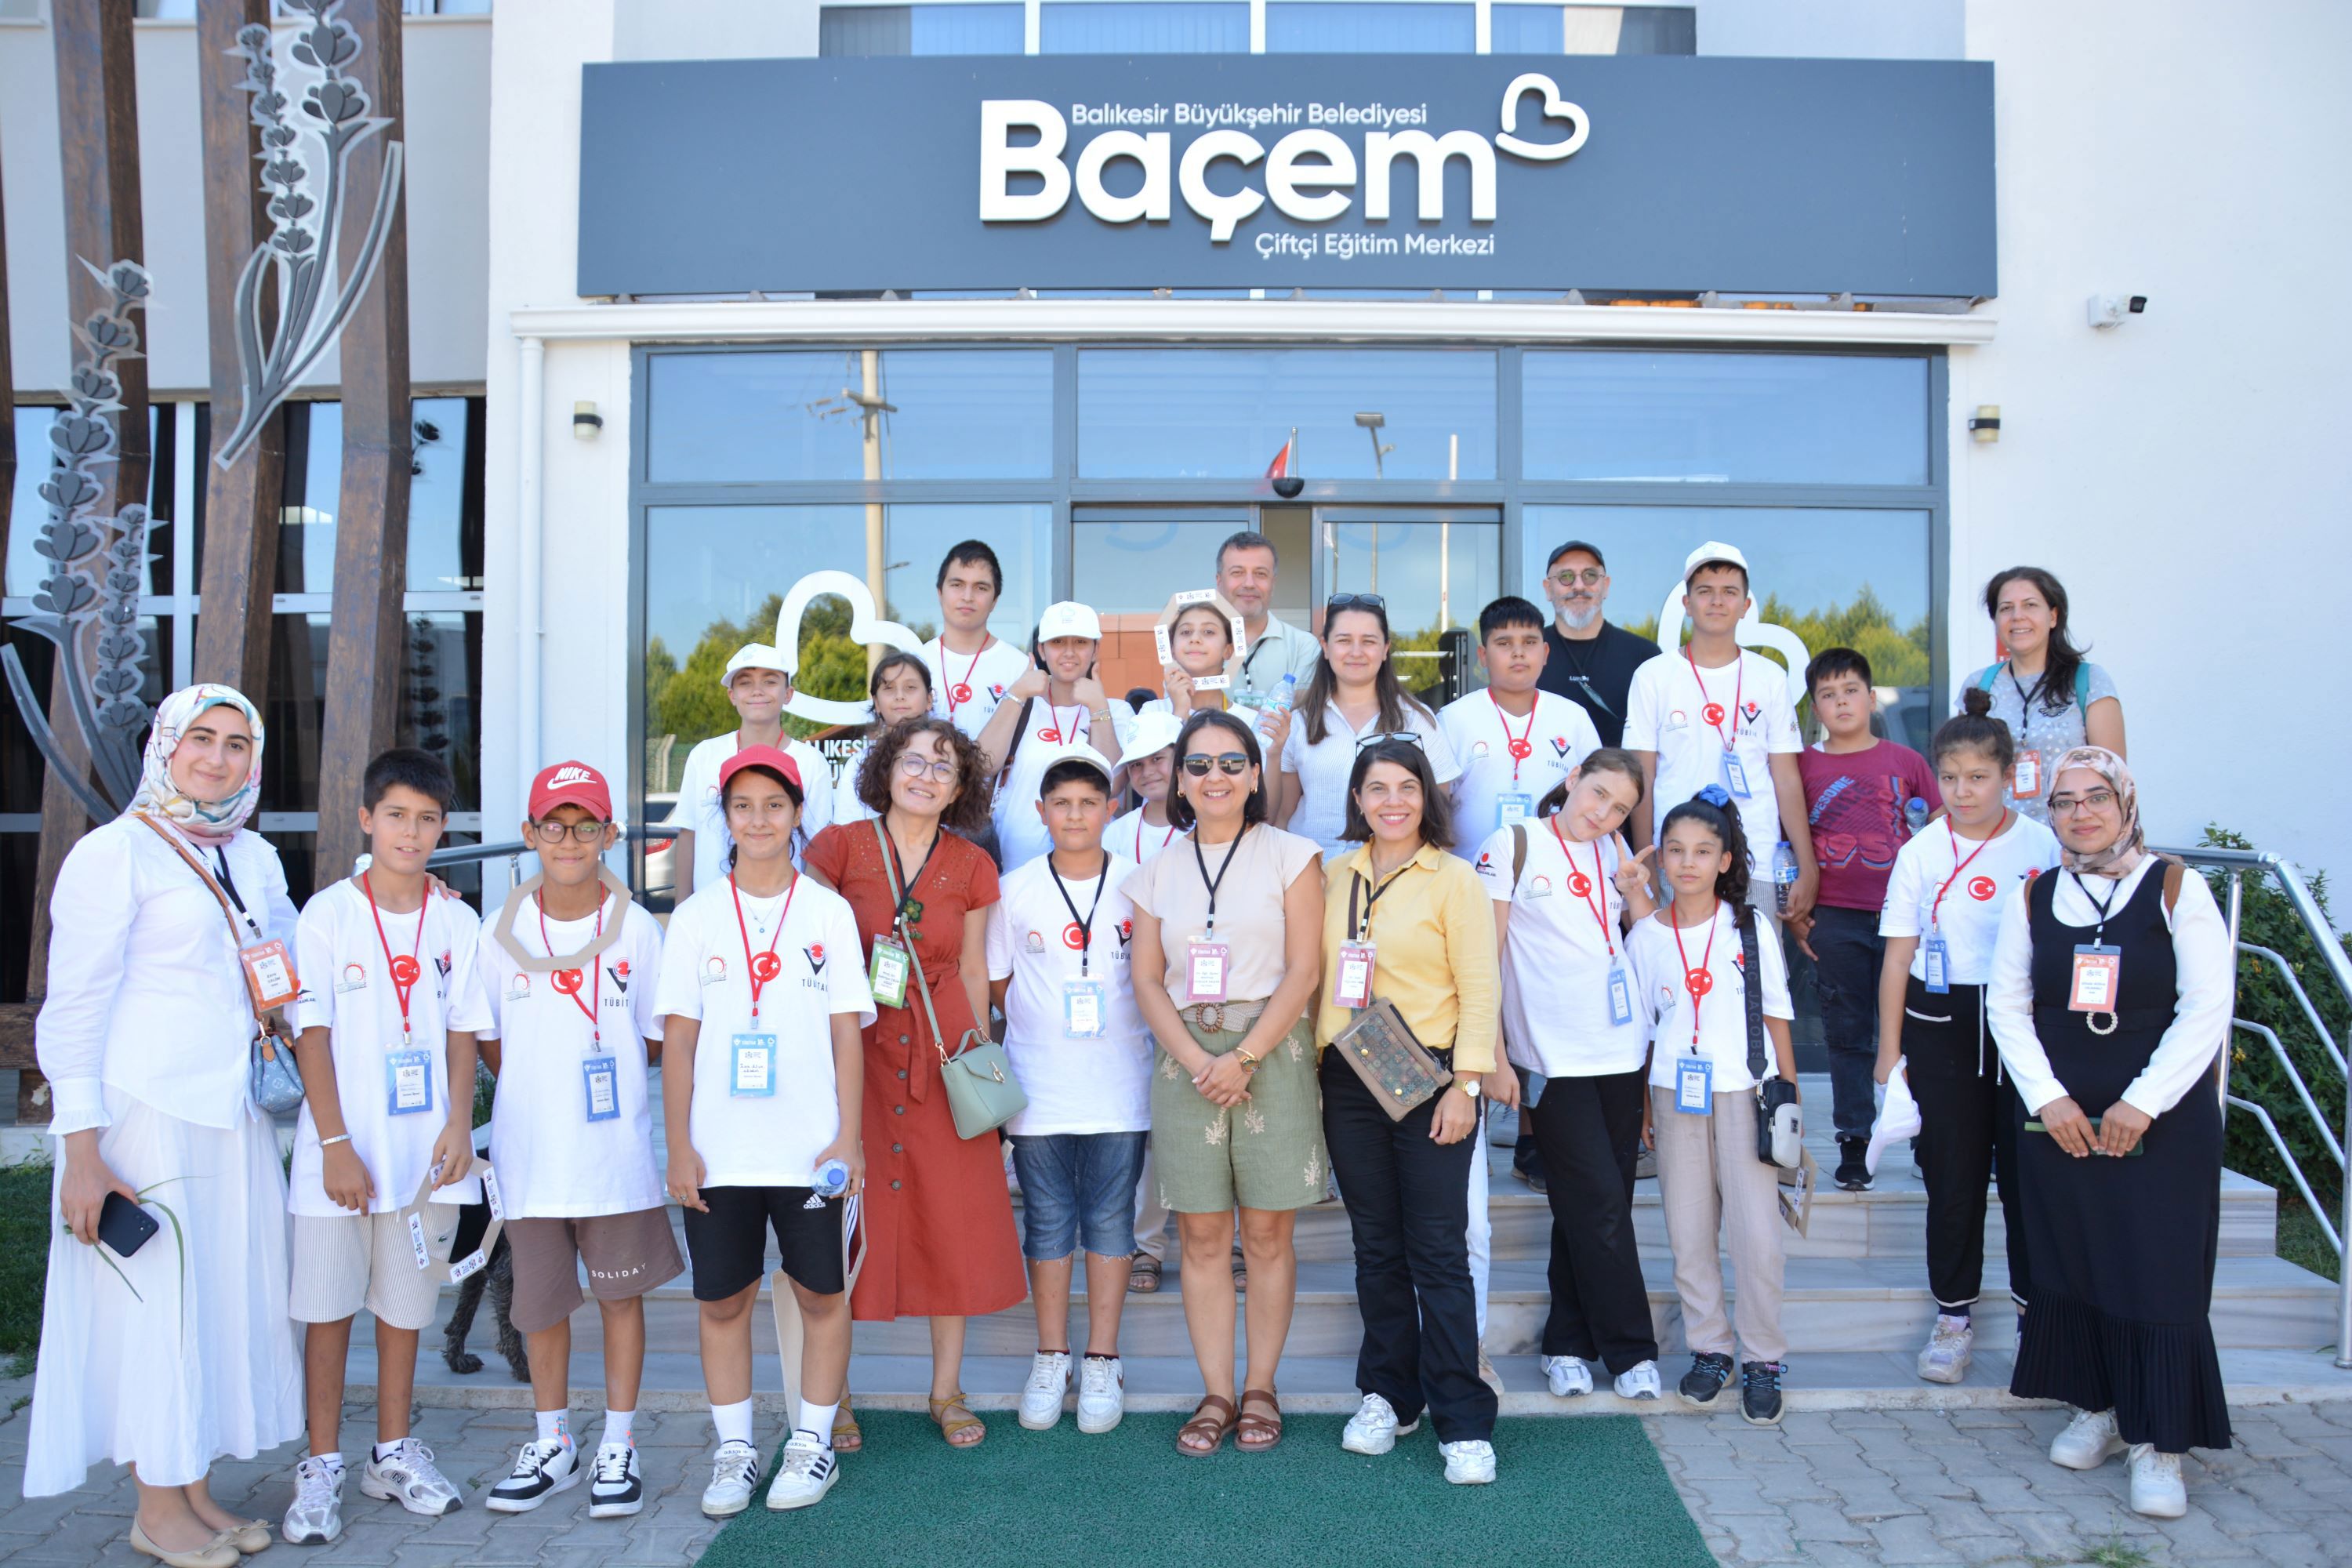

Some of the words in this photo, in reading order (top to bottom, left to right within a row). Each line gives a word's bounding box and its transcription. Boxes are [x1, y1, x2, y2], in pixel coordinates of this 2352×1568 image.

[1072, 103, 1169, 125] Balıkesir
[1174, 103, 1302, 130] Büyükşehir
[1308, 103, 1427, 129] Belediyesi
[979, 100, 1497, 241] Baçem
[1254, 233, 1318, 260] Çiftçi
[1324, 233, 1398, 260] Eğitim
[1404, 233, 1494, 255] Merkezi
[554, 767, 591, 781] NIKE
[1743, 934, 1758, 981] MARC
[604, 997, 629, 1007] TÜBİT
[1748, 990, 1763, 1058] JACOBS
[591, 1262, 646, 1279] SOLIDAY
